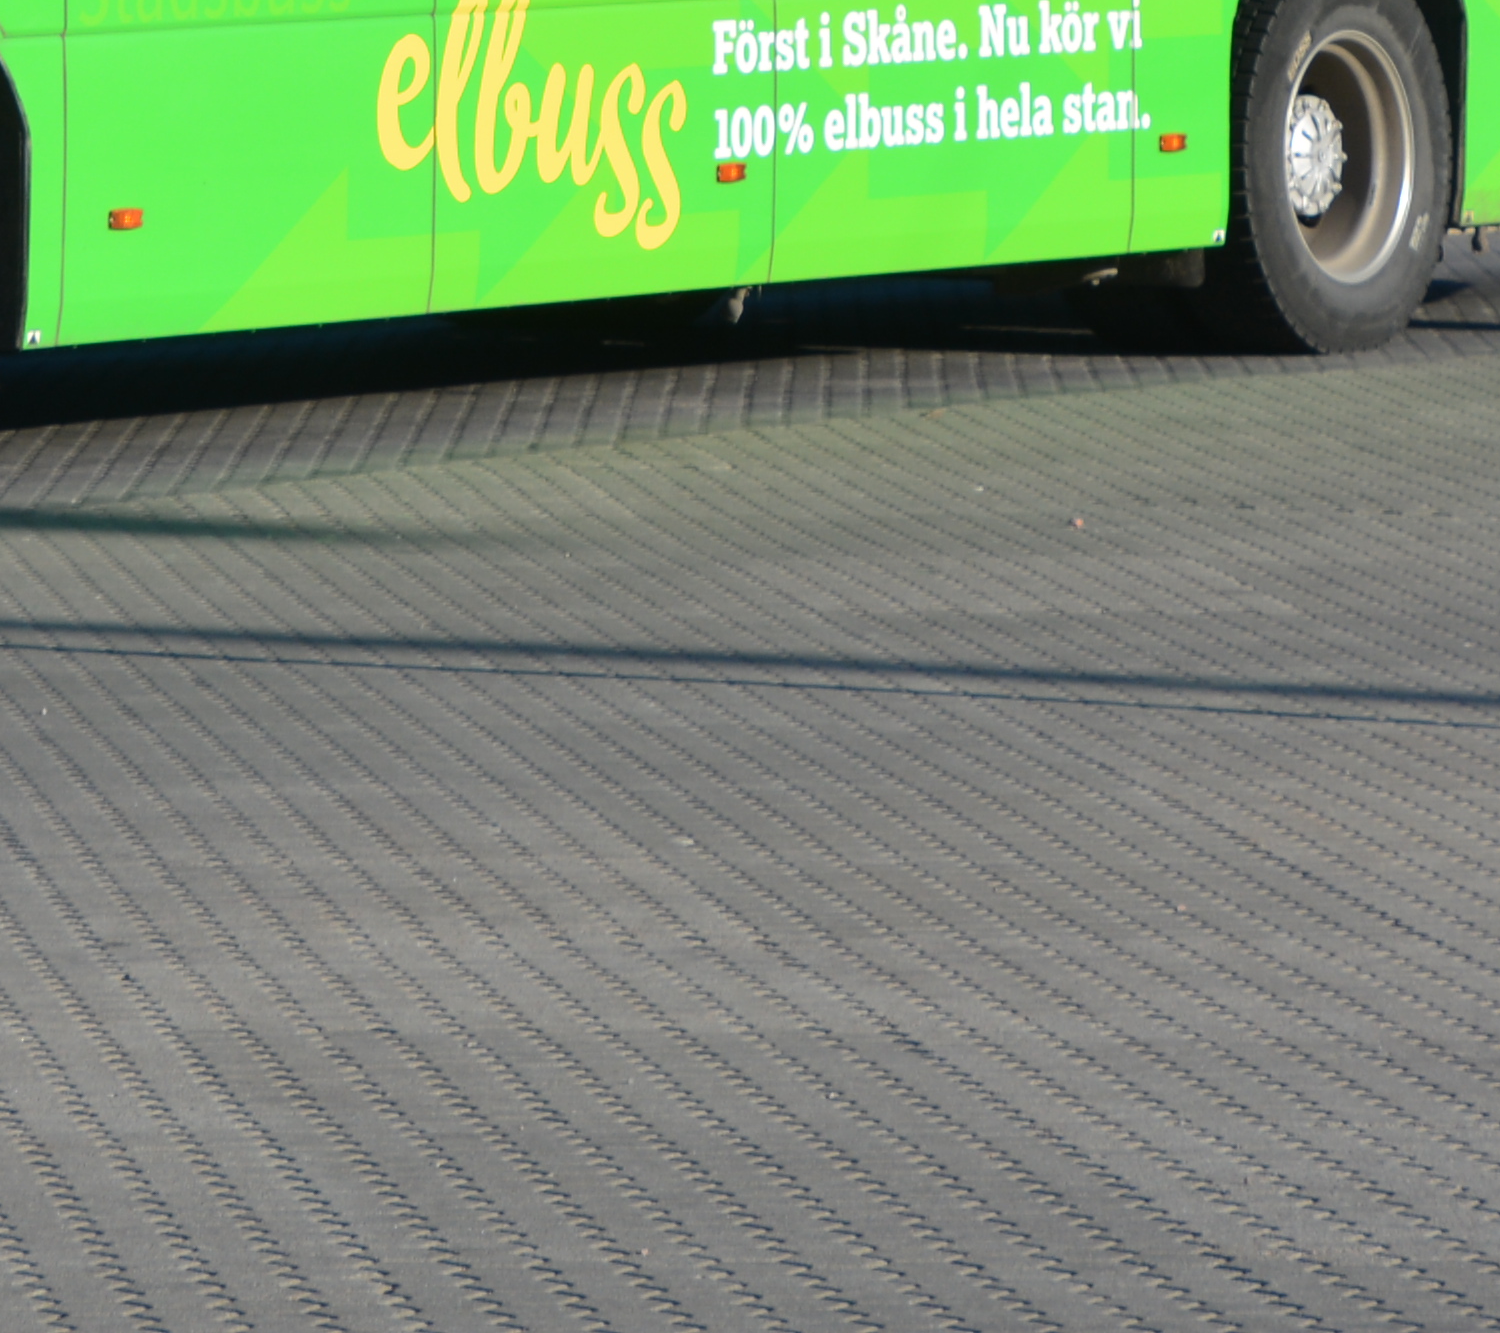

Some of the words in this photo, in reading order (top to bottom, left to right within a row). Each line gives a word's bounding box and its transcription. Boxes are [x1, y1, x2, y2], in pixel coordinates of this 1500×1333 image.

[712, 17, 811, 75] Först
[818, 12, 833, 69] i
[842, 3, 969, 69] Skåne.
[978, 2, 1031, 59] Nu
[1038, 0, 1100, 55] kör
[713, 101, 815, 160] 100%
[823, 92, 945, 151] elbuss
[953, 85, 969, 142] i
[976, 81, 1054, 140] hela
[1062, 81, 1152, 134] stan.
